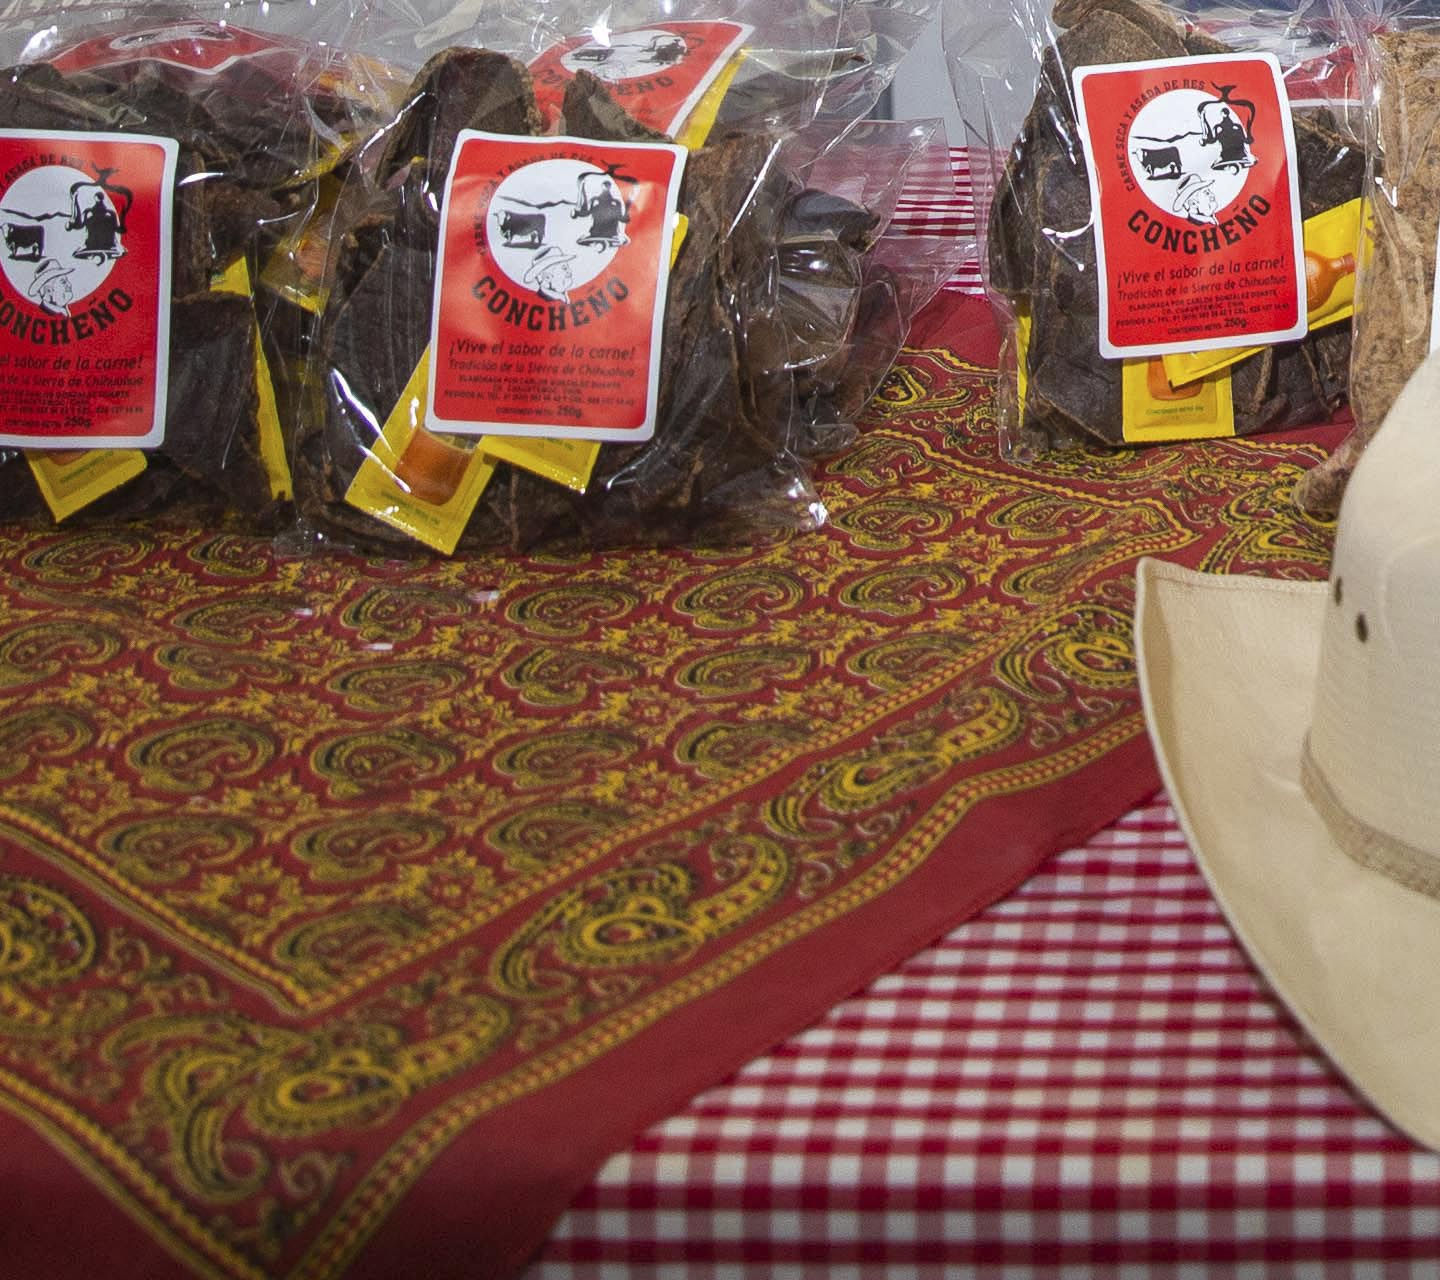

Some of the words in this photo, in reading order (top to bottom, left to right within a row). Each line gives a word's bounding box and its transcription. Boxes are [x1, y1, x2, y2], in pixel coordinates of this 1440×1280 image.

[1116, 122, 1128, 149] SECA
[1130, 86, 1162, 113] ASADA
[1164, 80, 1178, 91] DE
[1183, 79, 1205, 90] RES
[1128, 193, 1271, 255] CONCHEÑO
[1117, 271, 1149, 289] ¡Vive
[1154, 268, 1164, 281] el
[1170, 265, 1205, 280] sabor
[1209, 262, 1224, 276] de
[1229, 260, 1240, 273] la
[1245, 256, 1284, 271] carne!
[1166, 285, 1176, 296] de
[1224, 279, 1235, 289] de
[472, 276, 629, 332] CONCHEÑO
[492, 342, 503, 354] el
[509, 342, 544, 356] sabor
[549, 343, 565, 357] de
[571, 344, 583, 358] la
